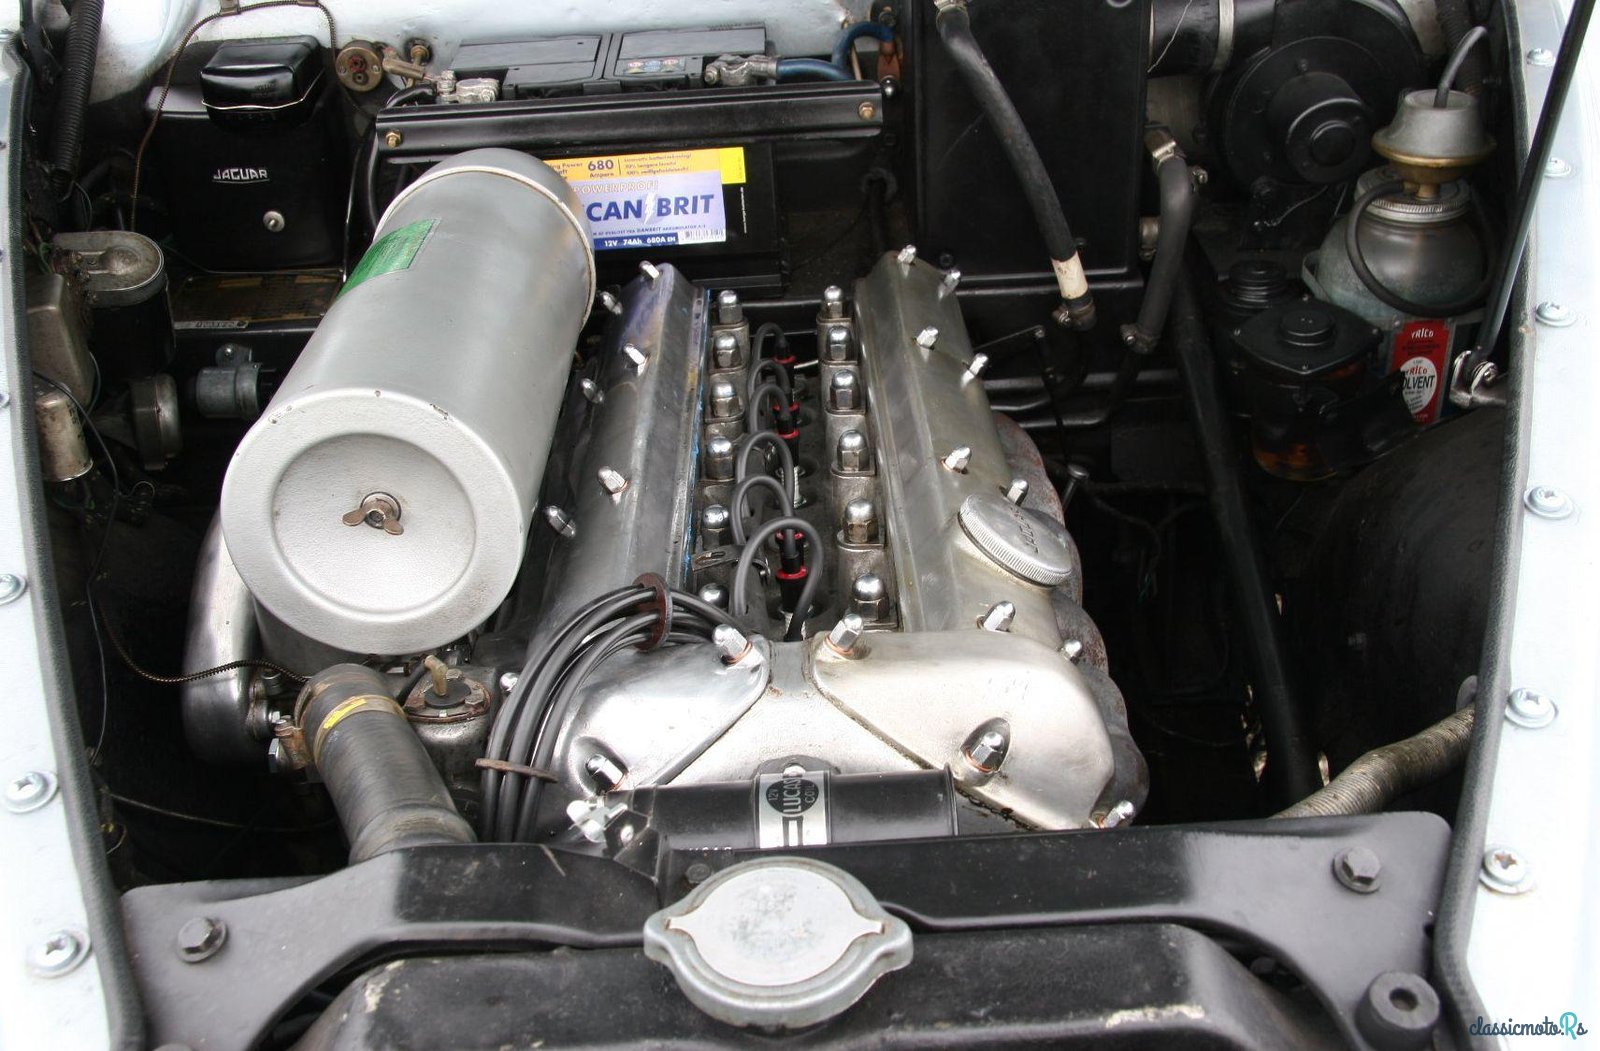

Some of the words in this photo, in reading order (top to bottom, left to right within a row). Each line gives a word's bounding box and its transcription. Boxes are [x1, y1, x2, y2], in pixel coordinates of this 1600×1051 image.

[588, 159, 614, 171] 680
[213, 168, 268, 180] JAGUAR
[583, 199, 642, 222] CAN
[657, 194, 714, 217] BRIT
[604, 239, 618, 247] 12V
[623, 237, 642, 246] 74Ah
[646, 236, 665, 244] 680A
[1402, 375, 1435, 390] OLVENT
[768, 788, 779, 801] 12V
[783, 778, 802, 813] LUCAS
[804, 784, 815, 803] COIL
